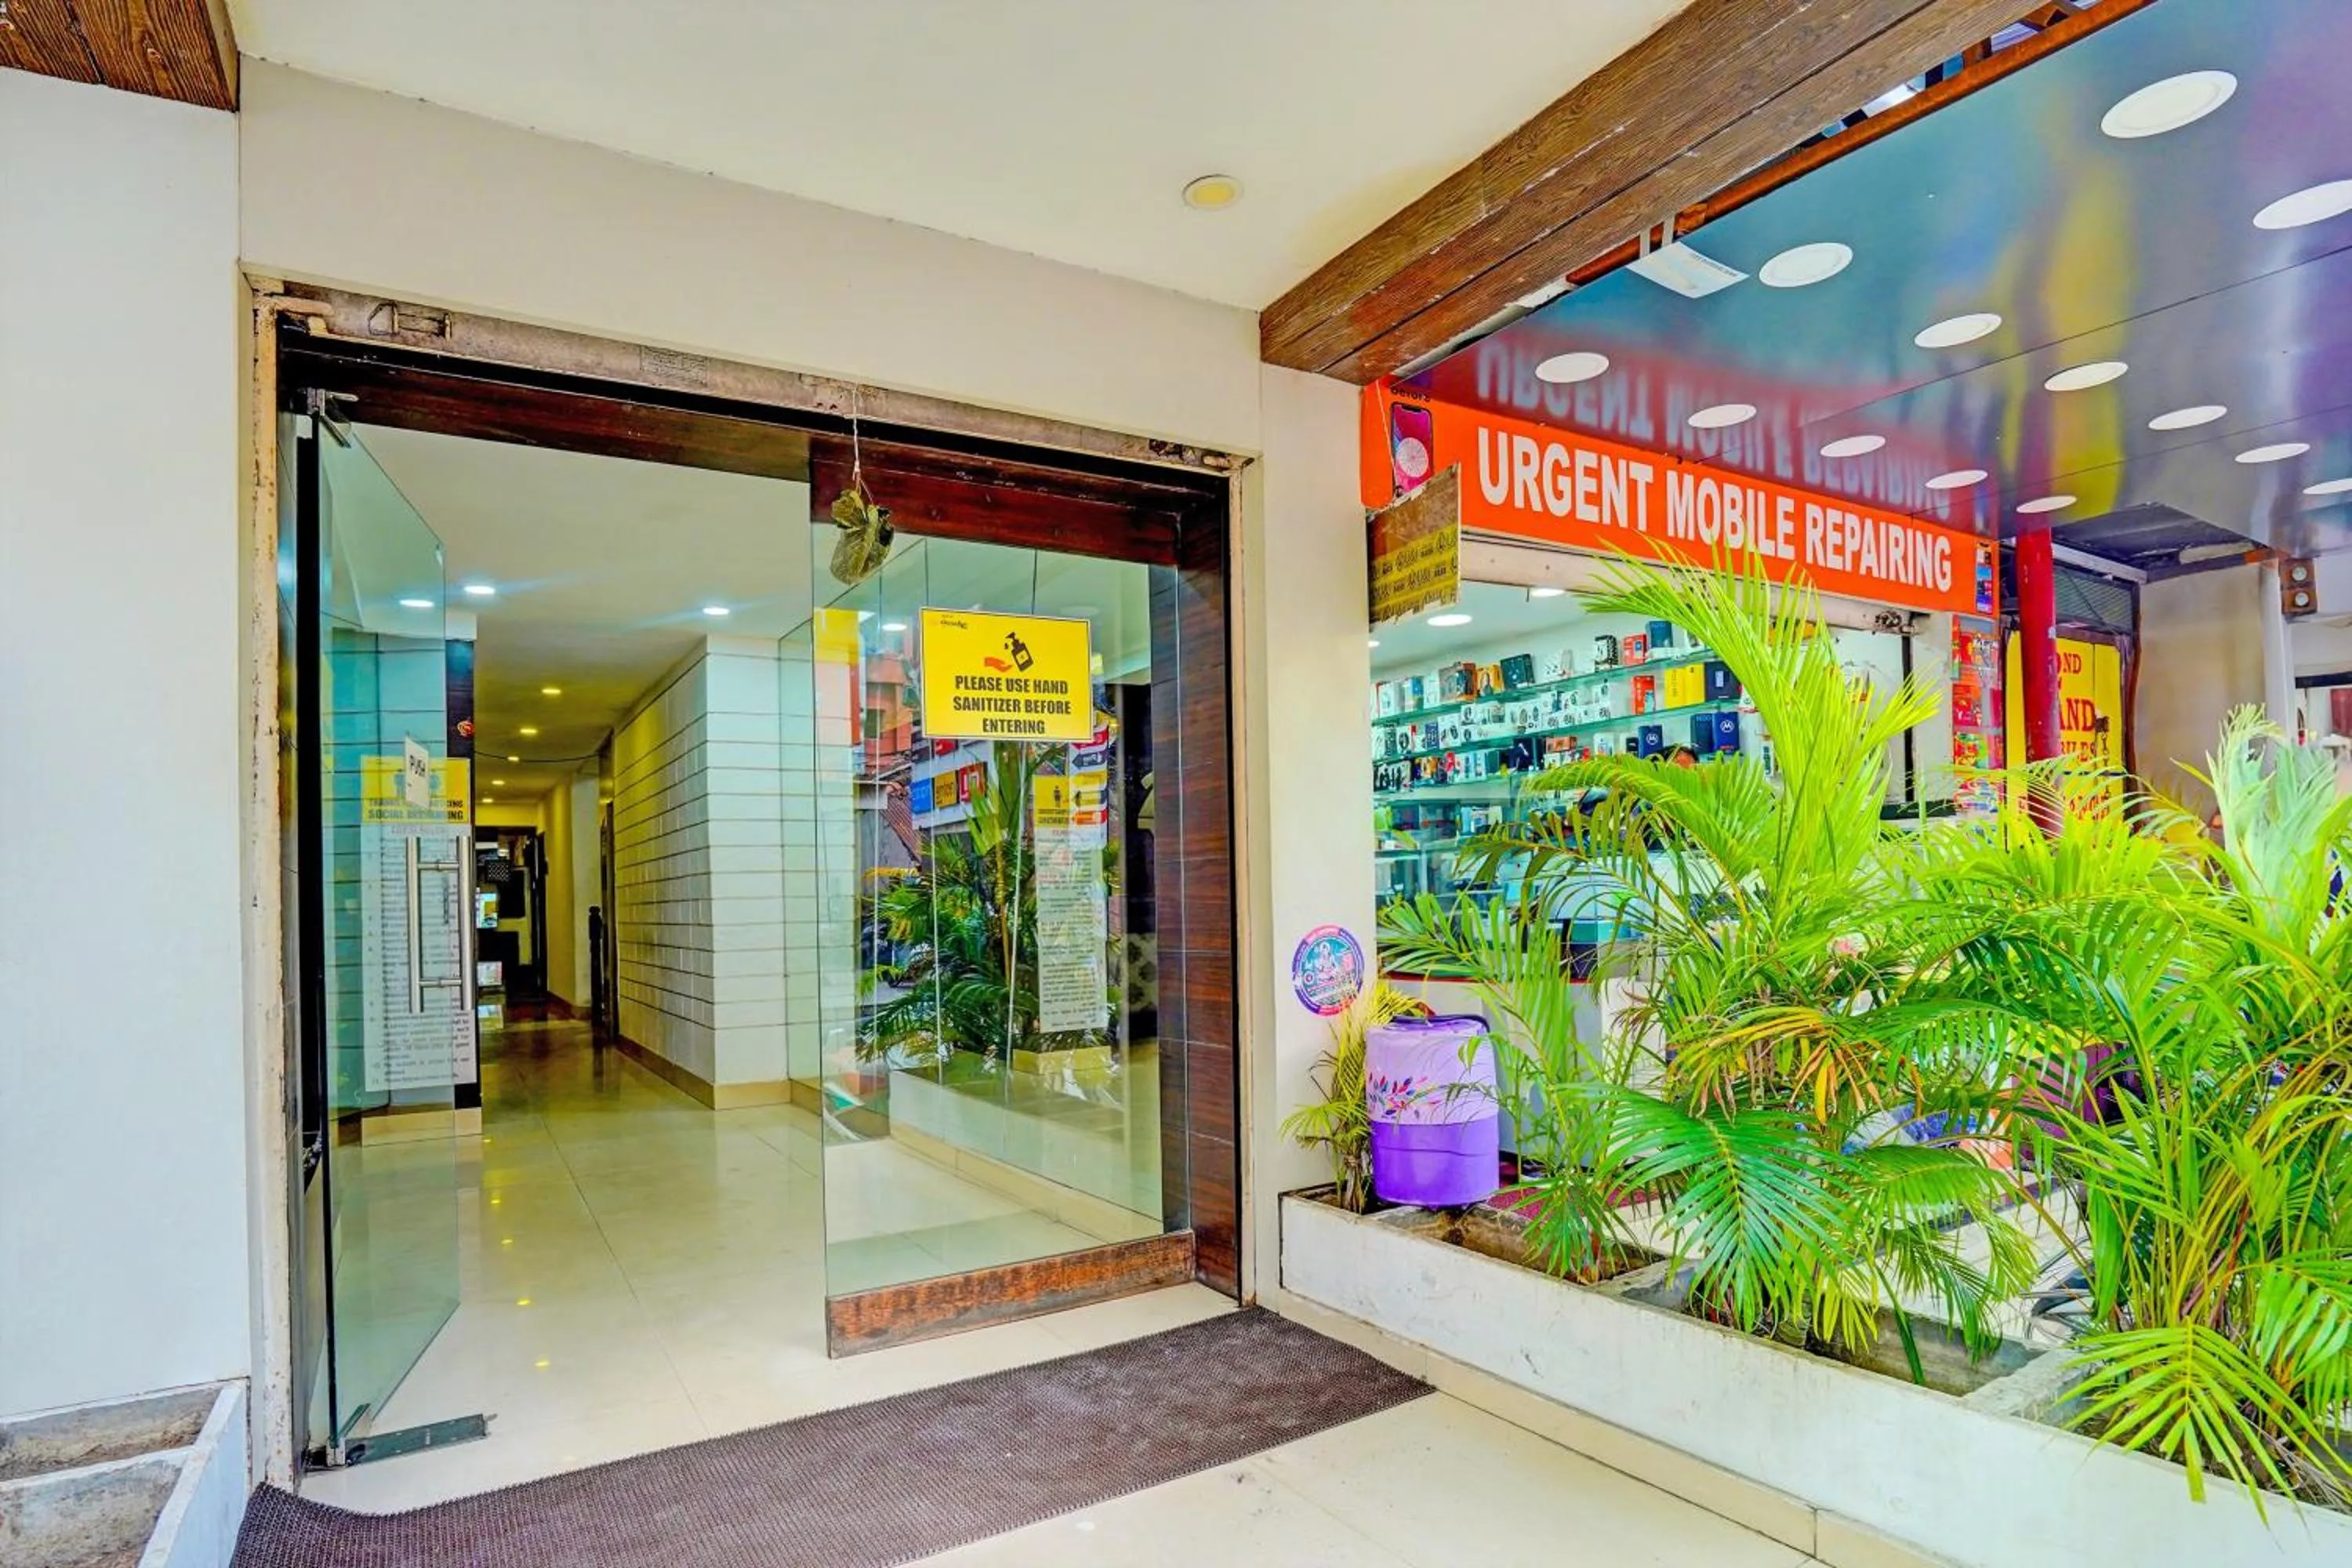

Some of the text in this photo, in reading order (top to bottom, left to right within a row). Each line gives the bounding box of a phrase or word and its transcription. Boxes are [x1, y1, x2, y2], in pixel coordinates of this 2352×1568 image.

[1478, 426, 1952, 593] URGENT MOBILE REPAIRING
[954, 675, 1069, 695] PLEASE USE HAND
[953, 695, 1072, 714] SANITIZER BEFORE
[982, 718, 1045, 735] ENTERING
